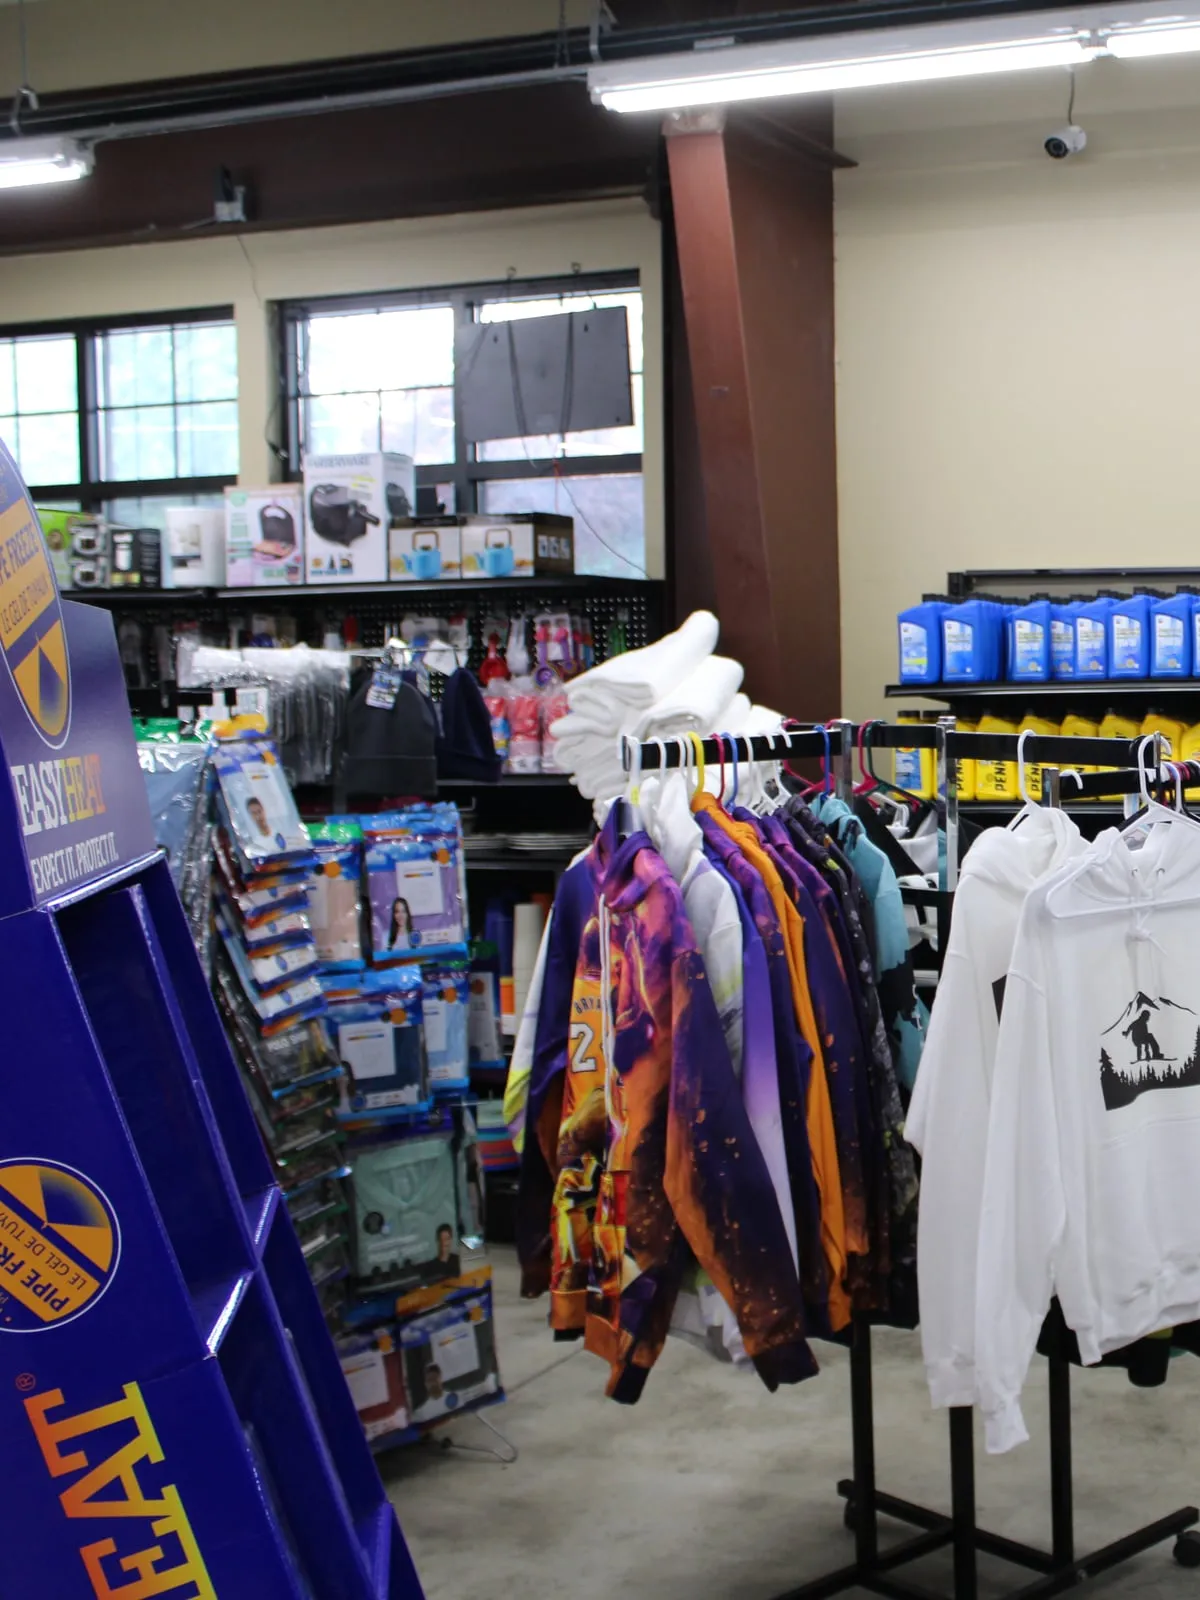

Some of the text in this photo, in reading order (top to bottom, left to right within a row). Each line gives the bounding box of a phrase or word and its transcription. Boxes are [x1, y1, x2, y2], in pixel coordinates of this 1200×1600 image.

[10, 752, 106, 837] EASYHEAT
[30, 851, 66, 894] EXPECT
[75, 836, 107, 877] PROTECT
[568, 1023, 602, 1074] 2
[0, 1212, 89, 1291] LE GEL DE TUY
[20, 1268, 70, 1313] PIPE
